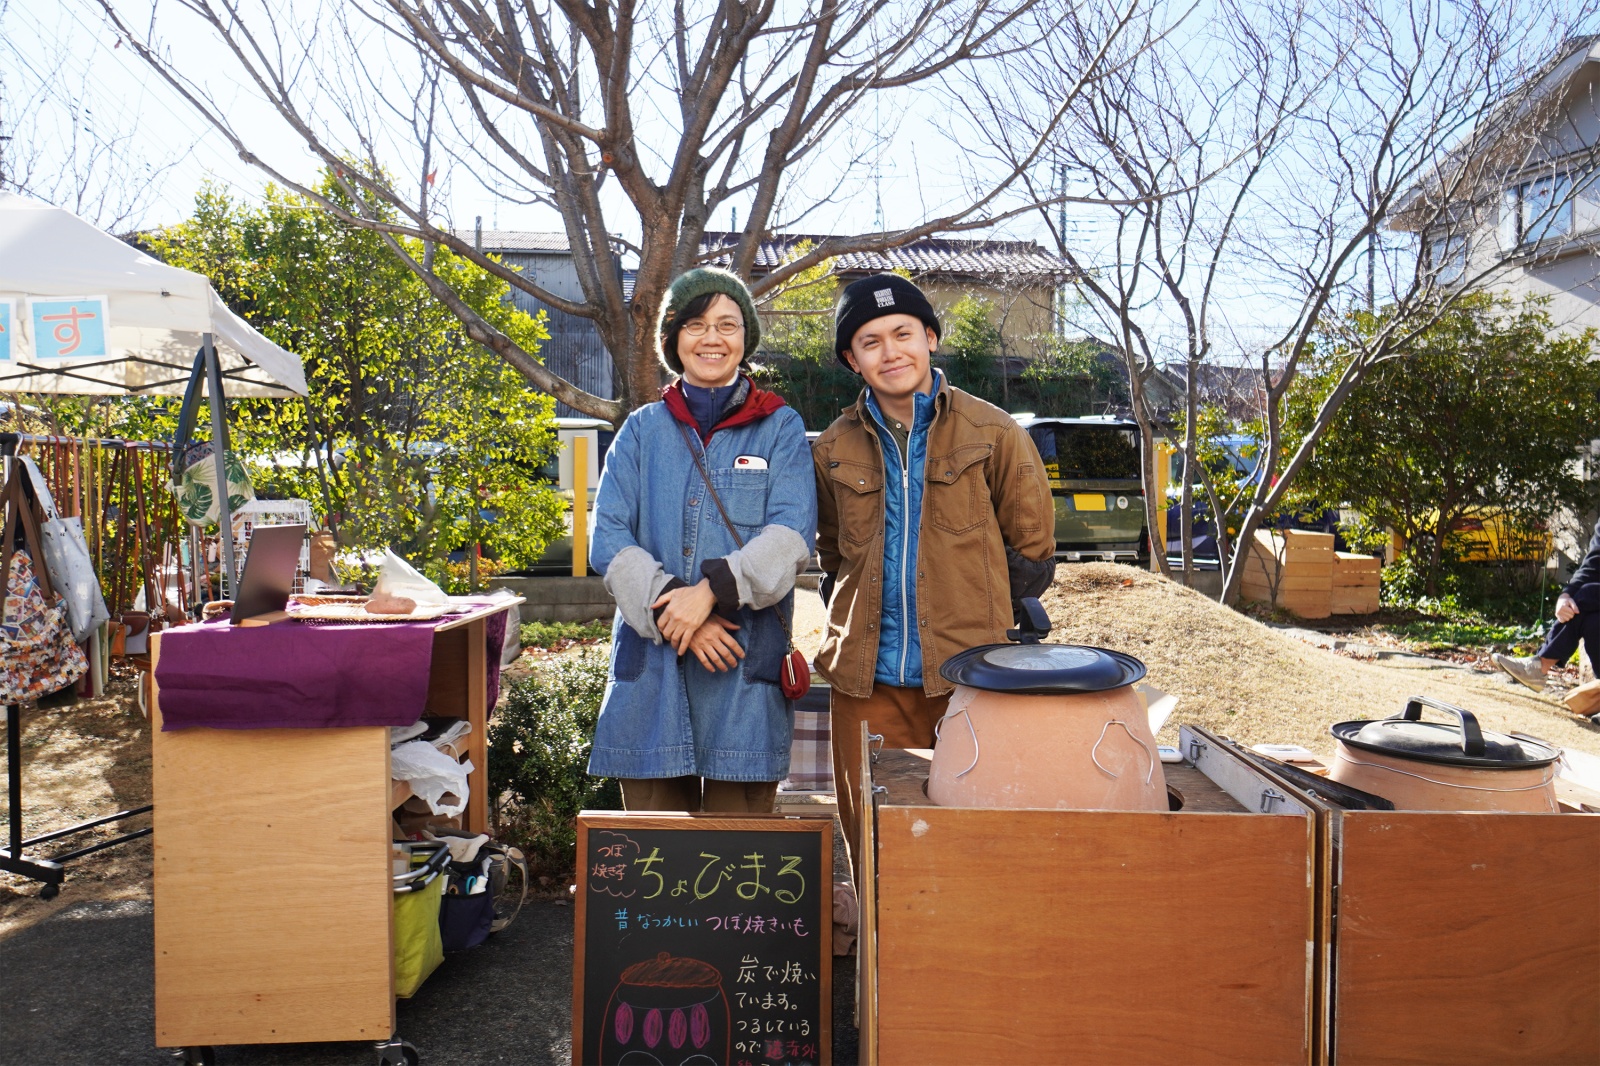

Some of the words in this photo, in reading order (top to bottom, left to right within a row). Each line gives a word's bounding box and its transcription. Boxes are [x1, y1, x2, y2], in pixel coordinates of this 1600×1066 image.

[42, 306, 95, 355] す
[597, 844, 628, 857] つぼ
[591, 863, 628, 881] 焼き芋
[633, 847, 805, 904] ちょびまる
[614, 907, 629, 931] 昔
[705, 912, 810, 937] つぼ焼きいも
[736, 953, 817, 985] 炭で焼い
[735, 991, 798, 1011] ています。
[736, 1018, 811, 1036] つるしている
